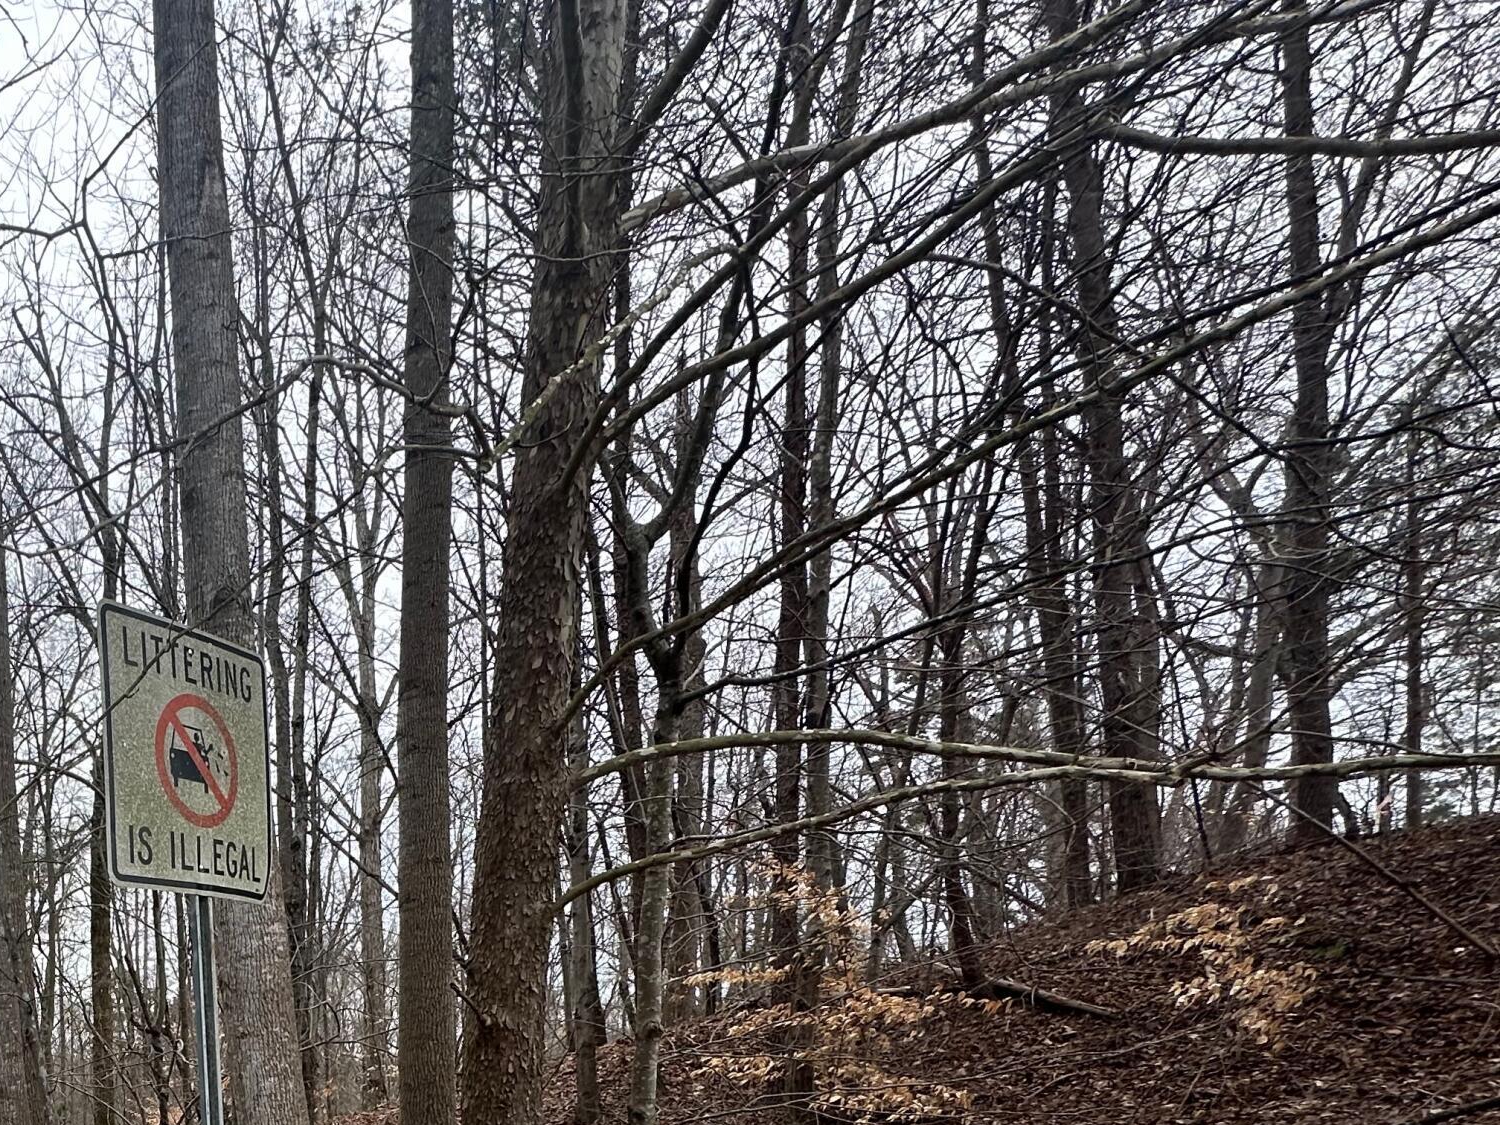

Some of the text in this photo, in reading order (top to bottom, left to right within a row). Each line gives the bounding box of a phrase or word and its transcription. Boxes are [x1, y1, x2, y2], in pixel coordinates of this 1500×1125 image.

[122, 626, 252, 703] LITTERING
[128, 825, 261, 883] IS ILLEGAL
